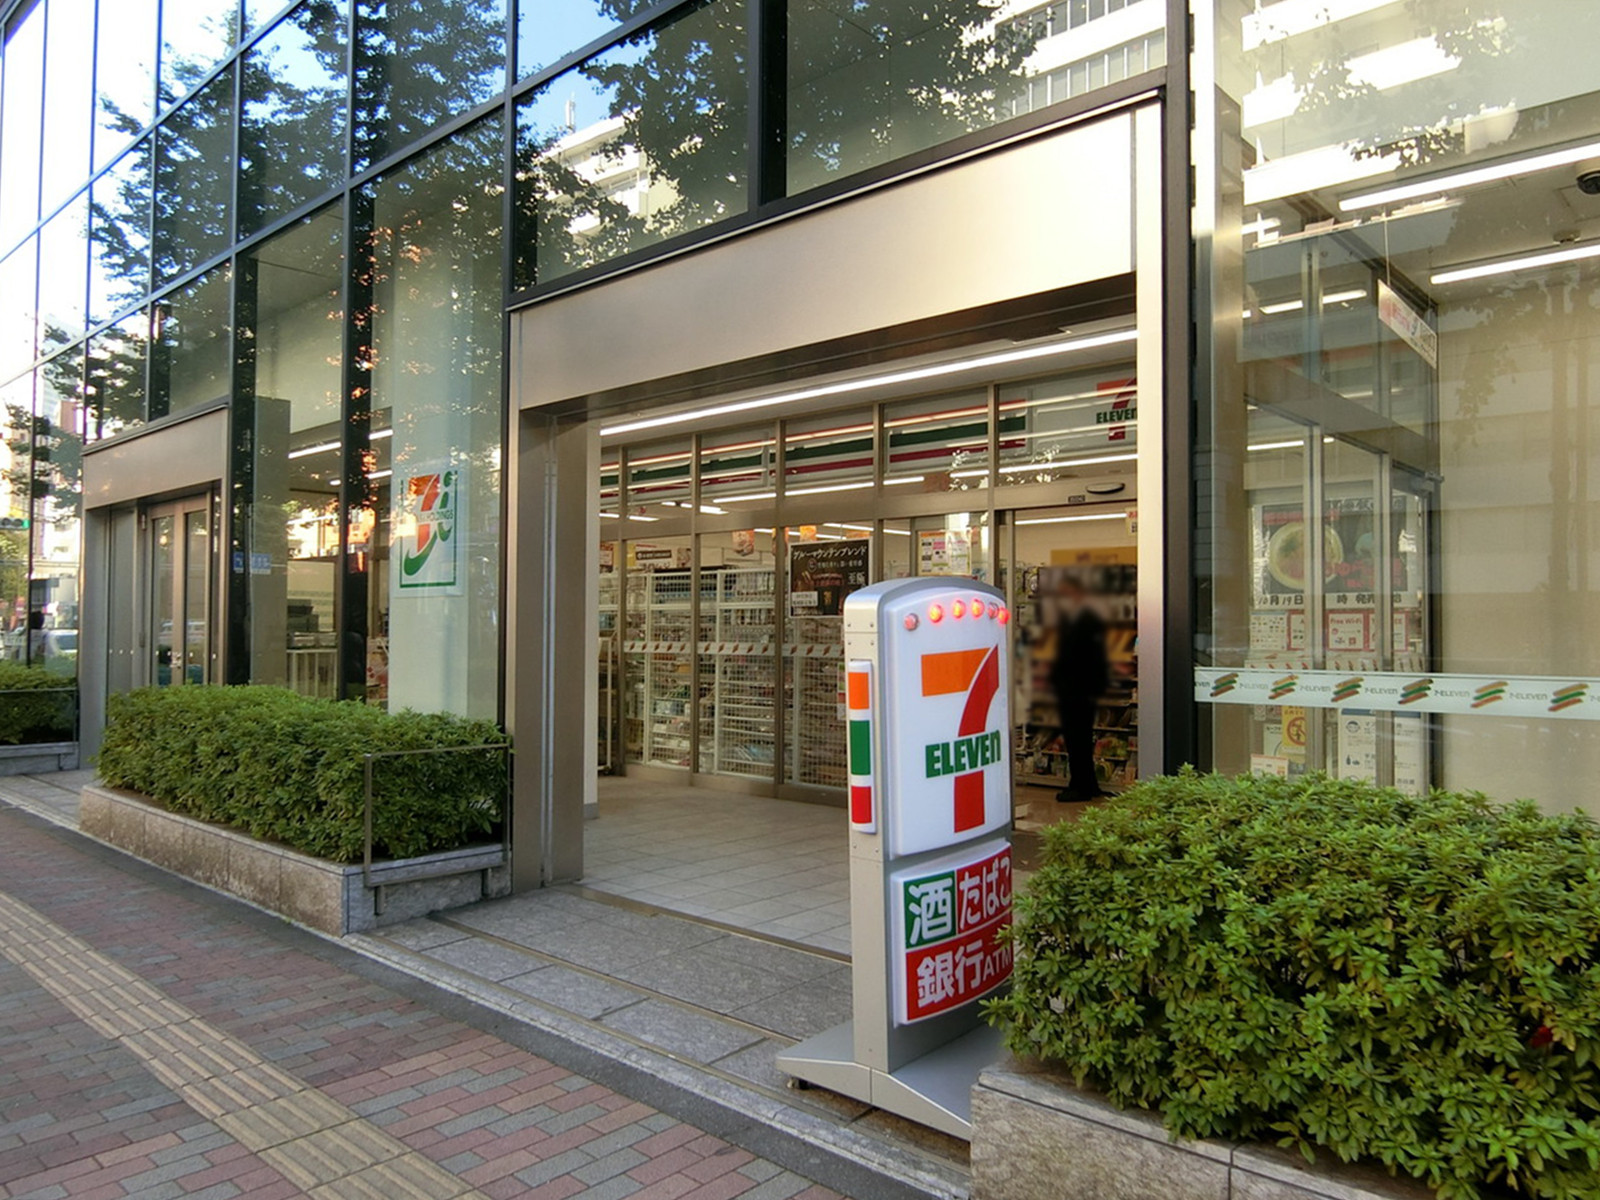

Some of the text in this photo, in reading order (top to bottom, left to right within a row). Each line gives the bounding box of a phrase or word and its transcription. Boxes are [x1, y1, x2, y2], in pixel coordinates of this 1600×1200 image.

[908, 878, 953, 947] 酒
[959, 857, 1011, 930] たばこ
